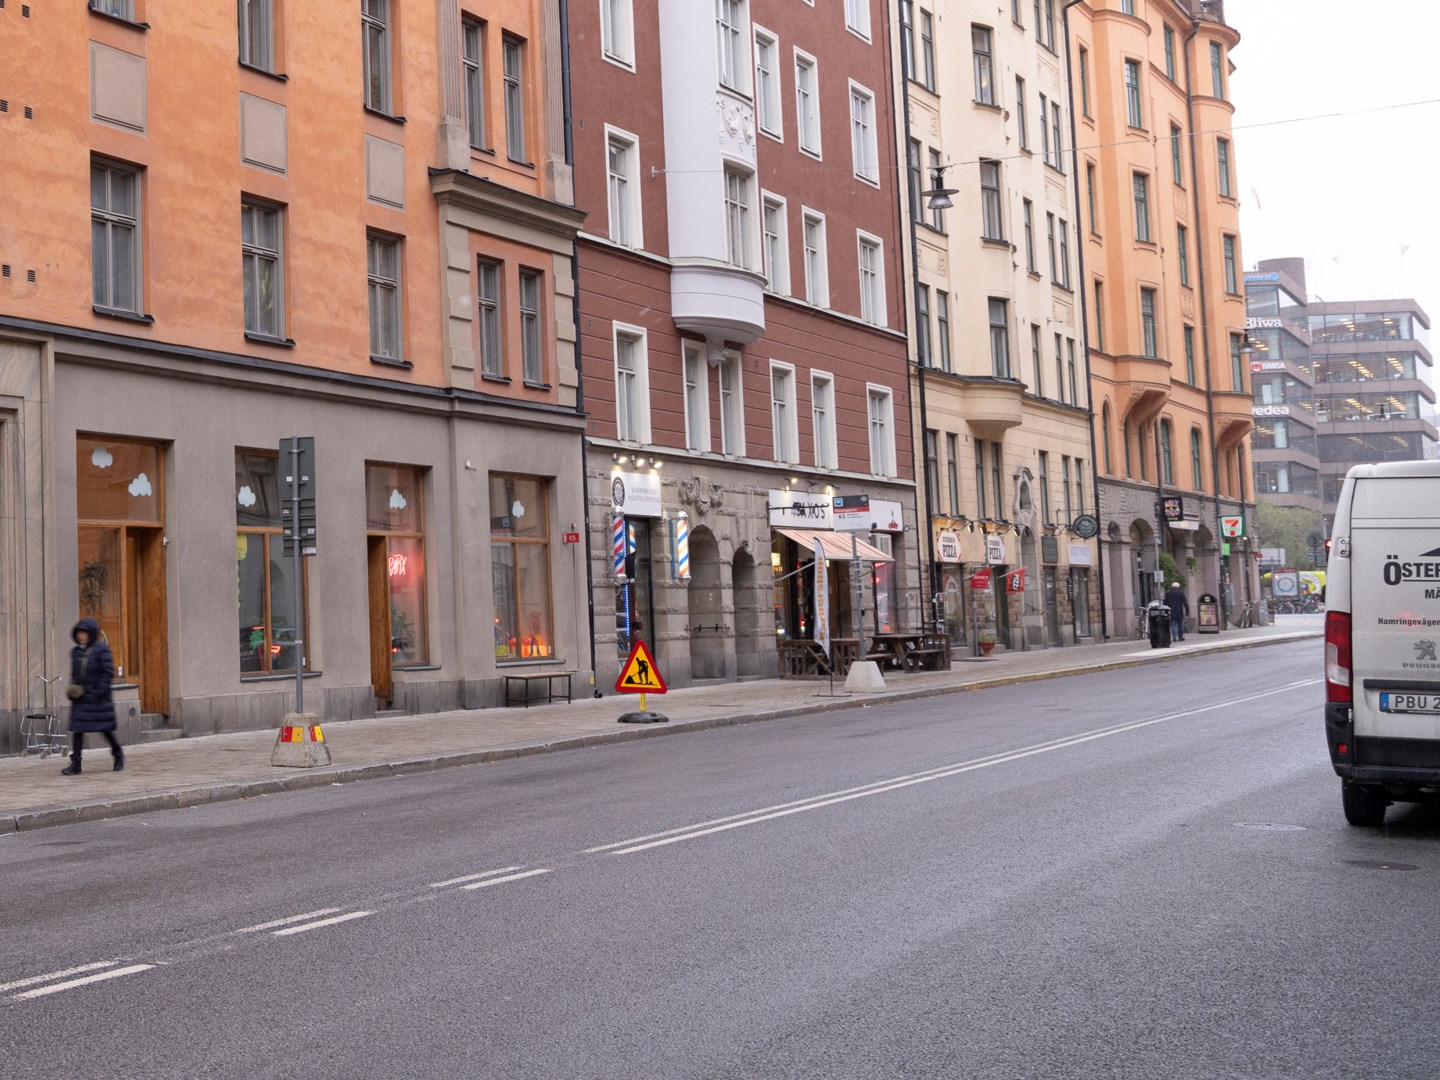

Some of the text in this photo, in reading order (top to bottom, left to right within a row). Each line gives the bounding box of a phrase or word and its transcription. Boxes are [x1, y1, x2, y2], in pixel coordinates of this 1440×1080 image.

[942, 544, 957, 558] PIZZA
[988, 547, 1002, 560] PIZZA
[1395, 695, 1427, 709] PBU
